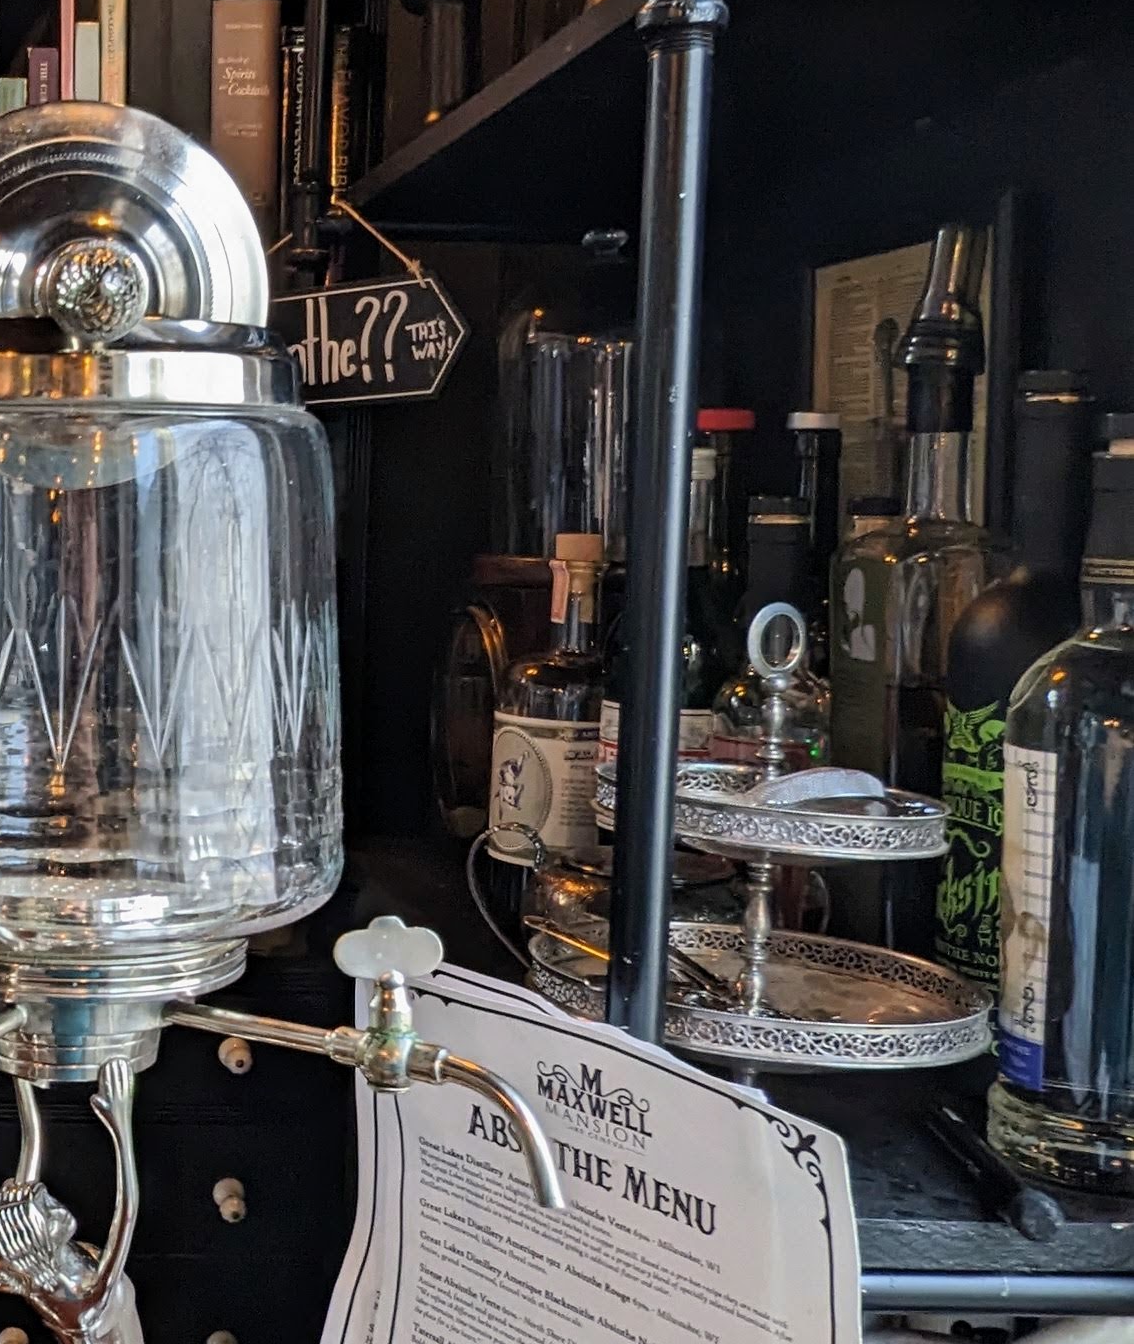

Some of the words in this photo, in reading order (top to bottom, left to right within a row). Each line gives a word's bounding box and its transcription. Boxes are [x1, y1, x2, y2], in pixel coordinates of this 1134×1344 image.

[222, 66, 256, 84] Spirits
[405, 319, 448, 342] THIS
[411, 336, 454, 361] WAY!
[537, 1075, 652, 1137] MAXWELL
[545, 1101, 646, 1150] MANSION
[439, 1144, 465, 1161] Lakes
[463, 1155, 504, 1178] Distillery
[506, 1171, 532, 1189] Amer
[467, 1103, 612, 1192] ABSTHE
[621, 1164, 717, 1236] MENU
[418, 1196, 443, 1214] Great
[442, 1207, 466, 1224] Lakes
[465, 1217, 504, 1242] Distillery
[564, 1263, 604, 1288] Absinthe
[418, 1229, 442, 1247] Great
[441, 1240, 465, 1258] Lakes
[464, 1251, 502, 1276] Distillery
[596, 1315, 637, 1341] Absinthe
[443, 1275, 479, 1299] Absinthe
